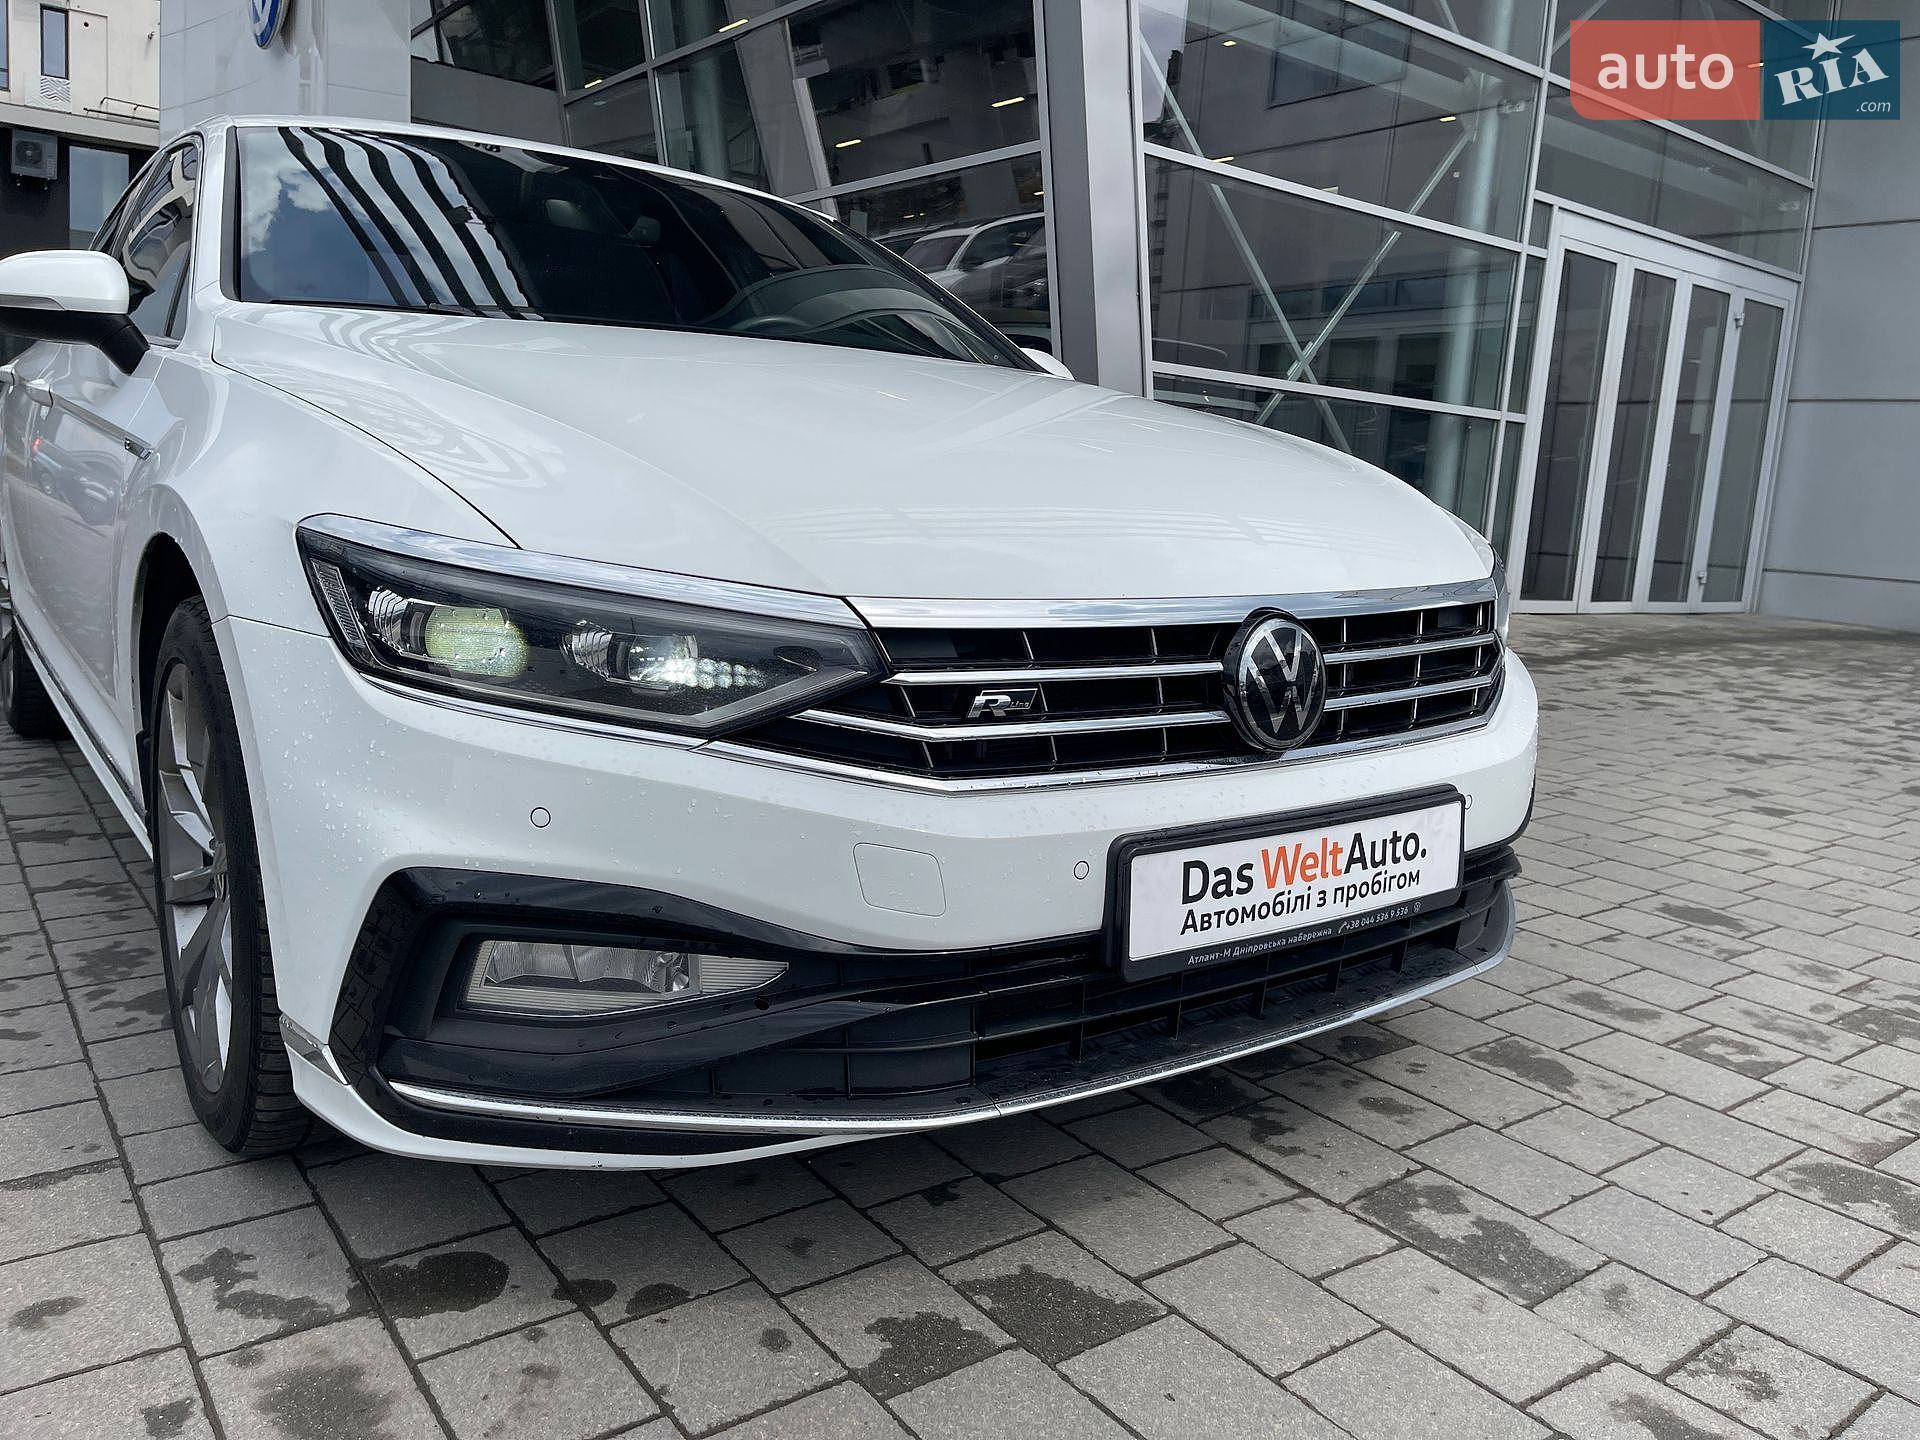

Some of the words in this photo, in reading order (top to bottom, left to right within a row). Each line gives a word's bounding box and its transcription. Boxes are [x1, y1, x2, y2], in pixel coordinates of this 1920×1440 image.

[1180, 884, 1311, 935] Автомобілі
[1316, 889, 1327, 908] з
[1333, 868, 1420, 907] пробігом
[1181, 860, 1254, 904] Das
[1187, 947, 1231, 965] Атлант-М
[1232, 937, 1286, 957] Дніпровська
[1288, 926, 1332, 945] набережна
[1361, 915, 1374, 927] 044
[1375, 911, 1389, 923] 536
[1395, 906, 1409, 917] 536
